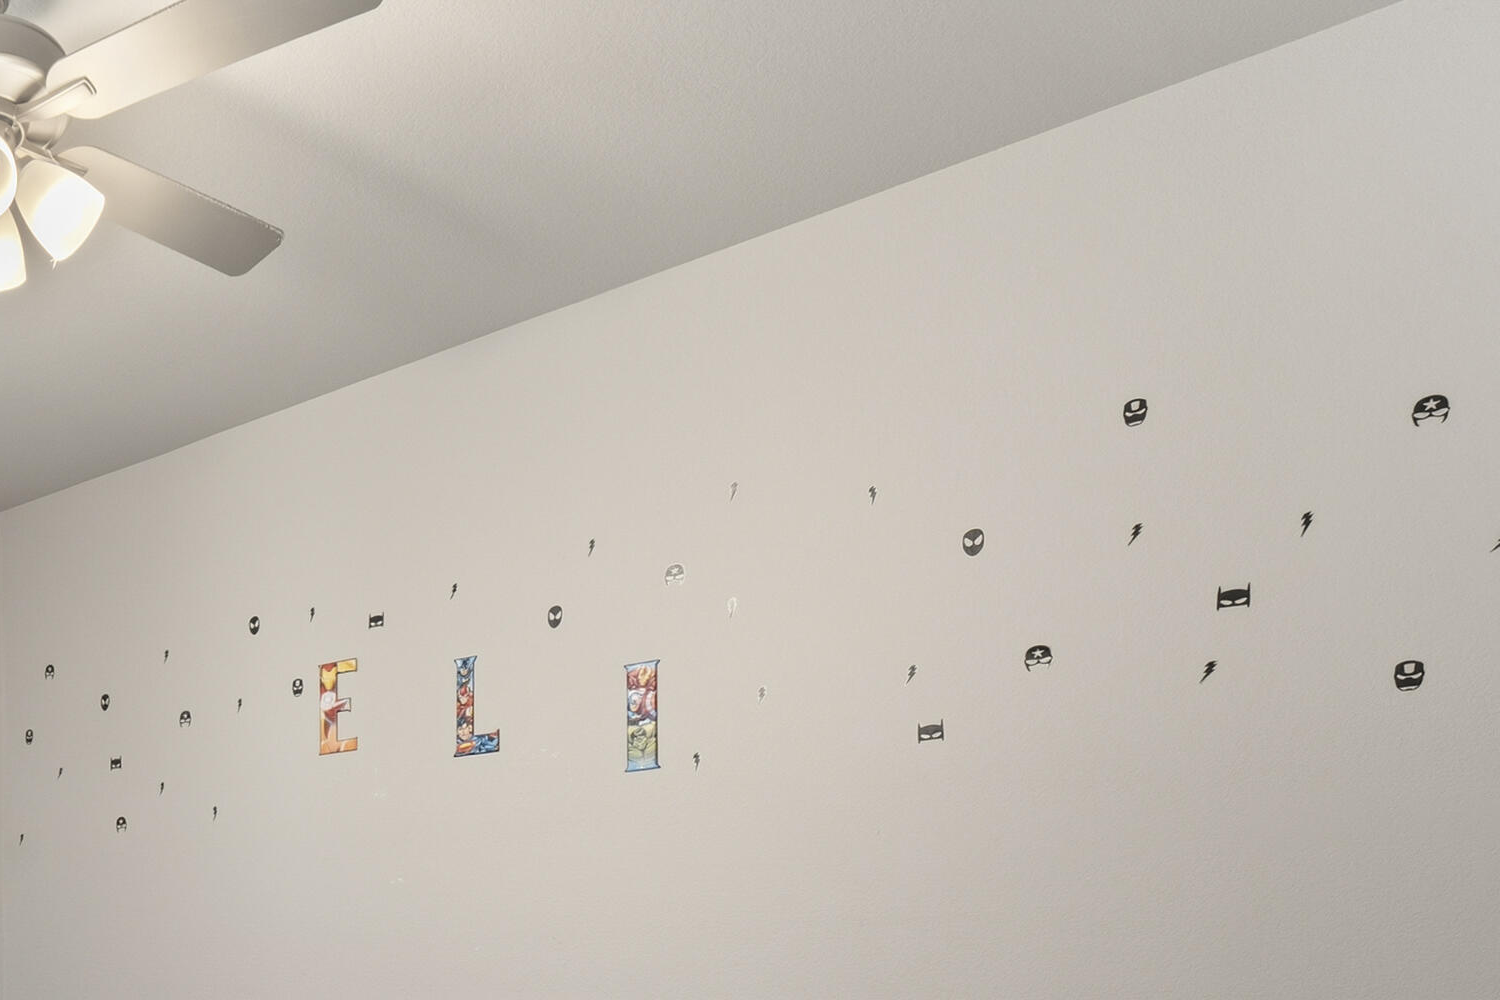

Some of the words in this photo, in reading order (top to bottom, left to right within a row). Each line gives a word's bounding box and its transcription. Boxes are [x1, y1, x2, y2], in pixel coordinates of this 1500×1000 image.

[318, 658, 358, 756] E
[453, 655, 500, 757] L
[624, 659, 661, 773] I
